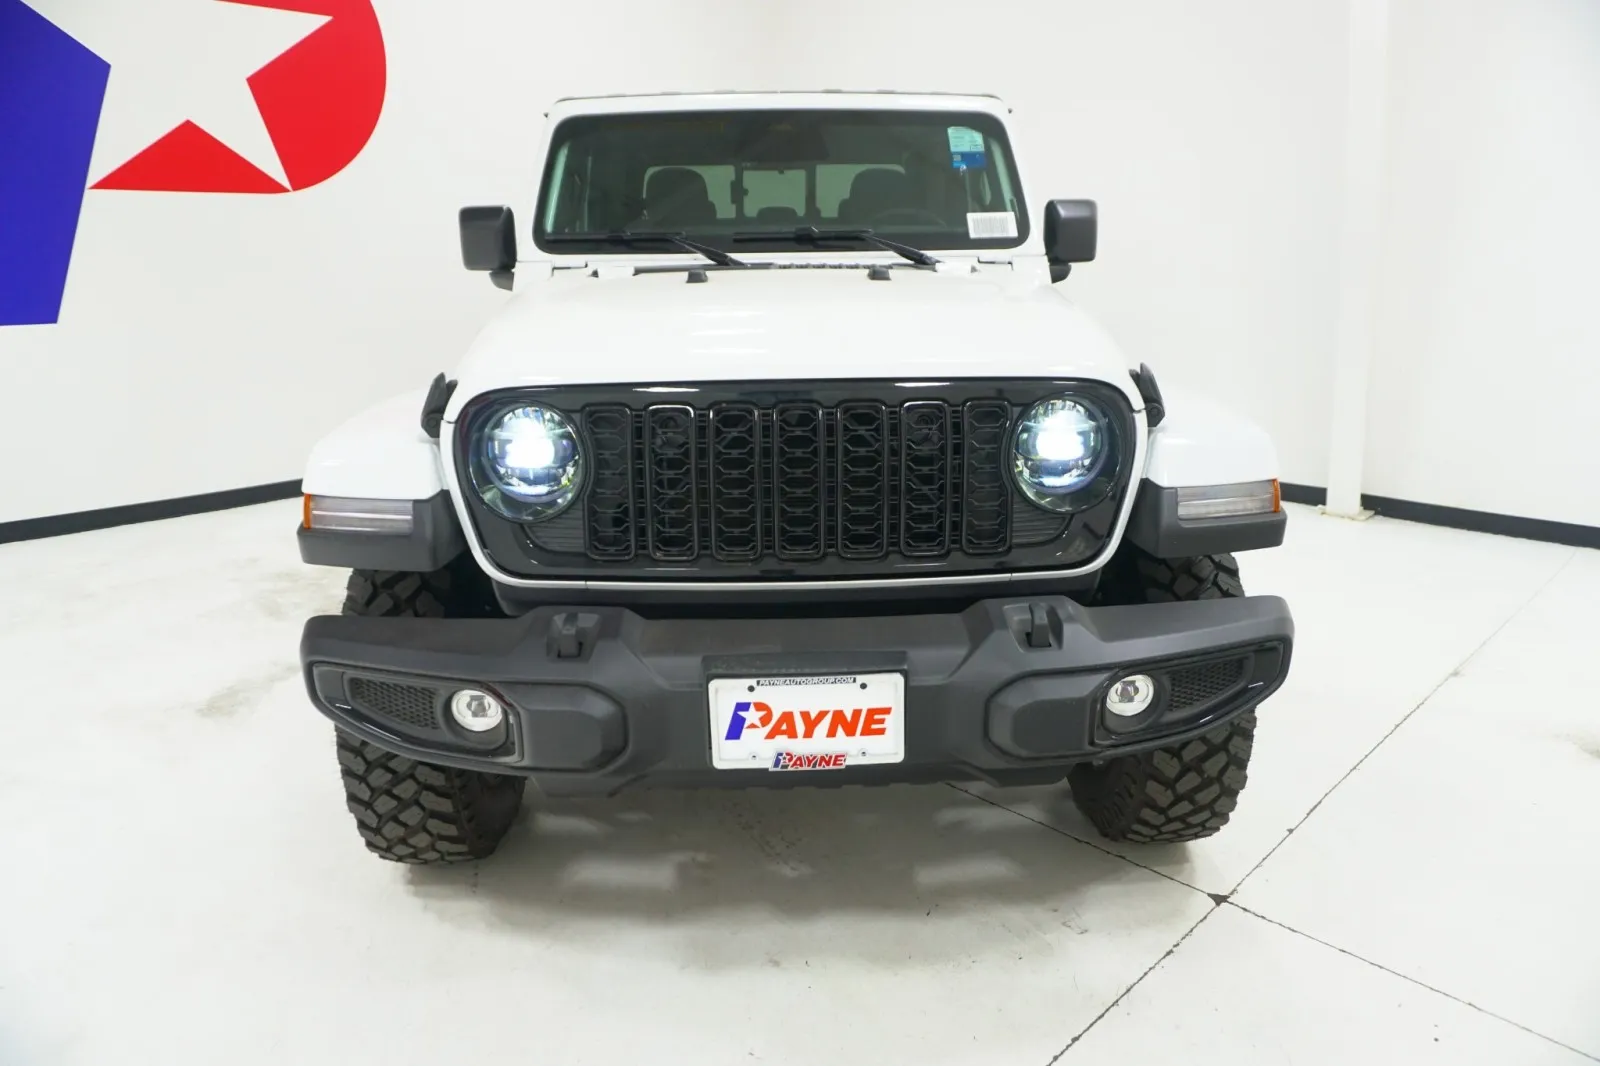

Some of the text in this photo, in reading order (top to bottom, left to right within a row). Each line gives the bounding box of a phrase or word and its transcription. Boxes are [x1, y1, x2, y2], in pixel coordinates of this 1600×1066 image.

[757, 677, 855, 687] PAYNEAUTOGROUP.COM
[725, 701, 892, 740] PAYNE
[772, 752, 846, 769] PAYNE
